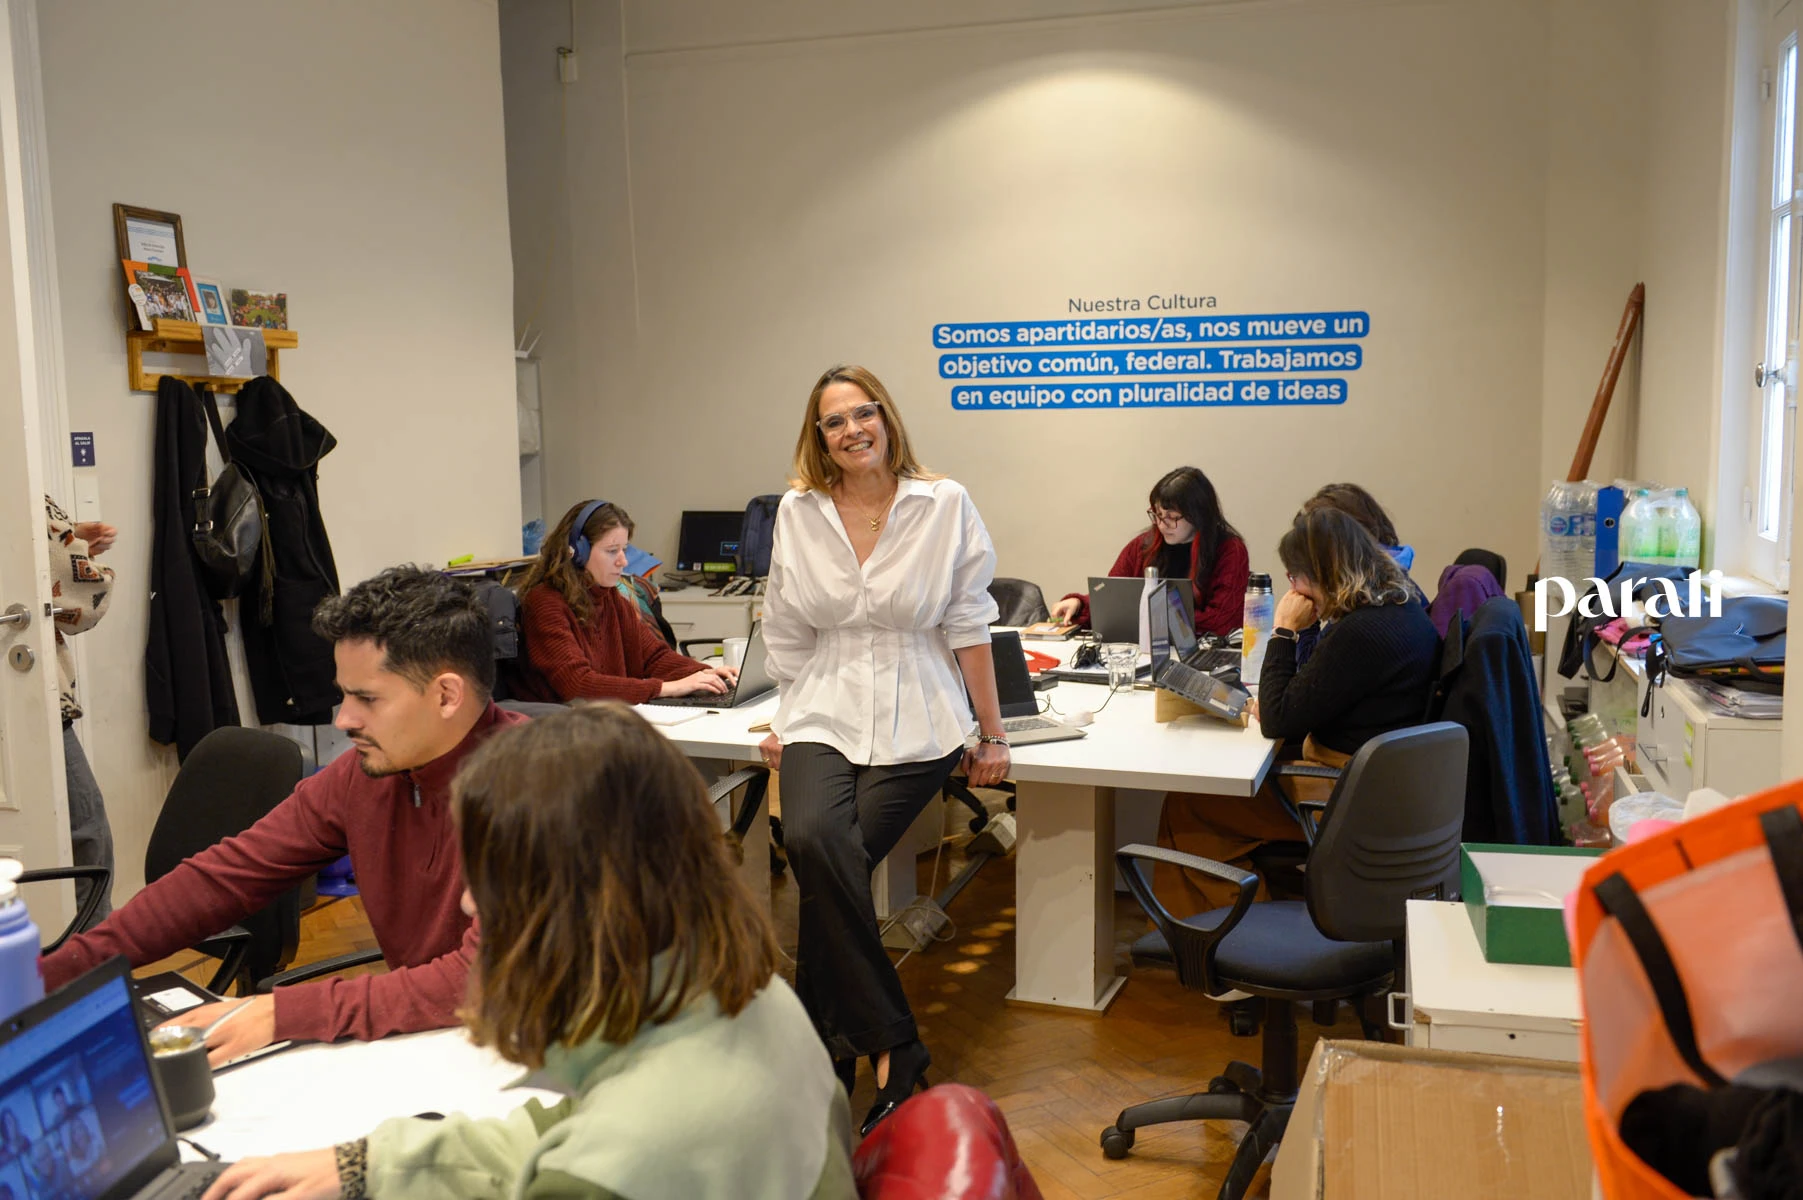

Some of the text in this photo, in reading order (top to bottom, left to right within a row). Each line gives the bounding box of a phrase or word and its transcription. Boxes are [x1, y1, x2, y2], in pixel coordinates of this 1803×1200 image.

[1068, 294, 1217, 312] Nuestra Cultura
[938, 317, 1364, 345] Somos apartidarios/as, nos mueve un
[943, 349, 1357, 377] objetivo común, federal. Trabajamos
[957, 380, 1341, 408] en equipo con pluralidad de ideas
